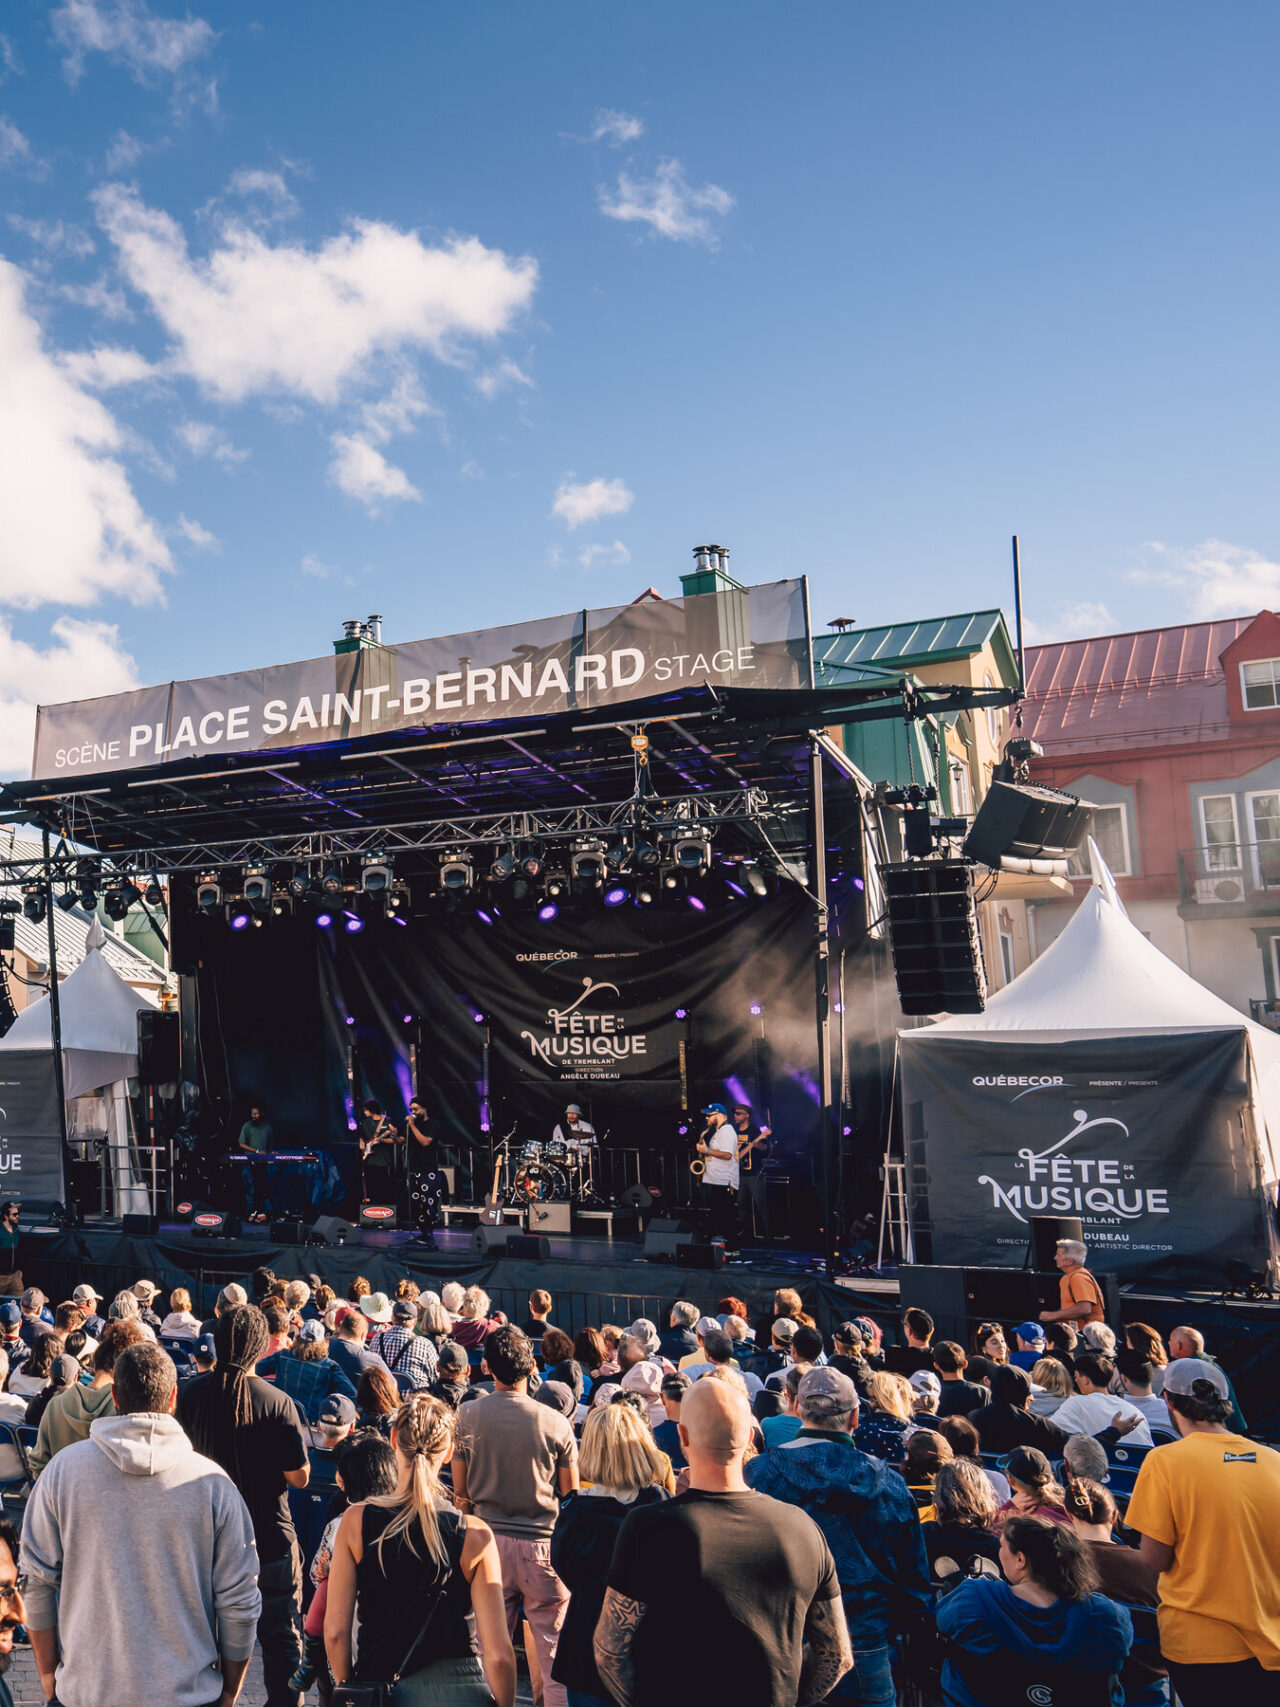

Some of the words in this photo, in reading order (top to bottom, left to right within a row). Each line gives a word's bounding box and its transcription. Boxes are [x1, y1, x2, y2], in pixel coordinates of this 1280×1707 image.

[54, 740, 120, 768] SCÈNE
[129, 705, 250, 758] PLACE
[262, 647, 646, 735] SAINT-BERNARD
[654, 646, 756, 682] STAGE
[516, 951, 578, 962] QUÉBECOR
[554, 1011, 616, 1034] FÊTE
[521, 1032, 647, 1064] MUSIQUE
[560, 1072, 589, 1080] ANGÈLE
[590, 1072, 620, 1080] DUBEAU
[972, 1074, 1065, 1087] QUÉBECOR
[1028, 1153, 1121, 1185] FÊTE
[978, 1176, 1170, 1221] MUSIQUE
[1080, 1216, 1122, 1225] MBLANT
[996, 1237, 1030, 1245] DIRECTI
[1094, 1242, 1130, 1250] ARTISTIC
[1131, 1244, 1173, 1252] DIRECTOR
[1083, 1232, 1130, 1242] DUBEAU
